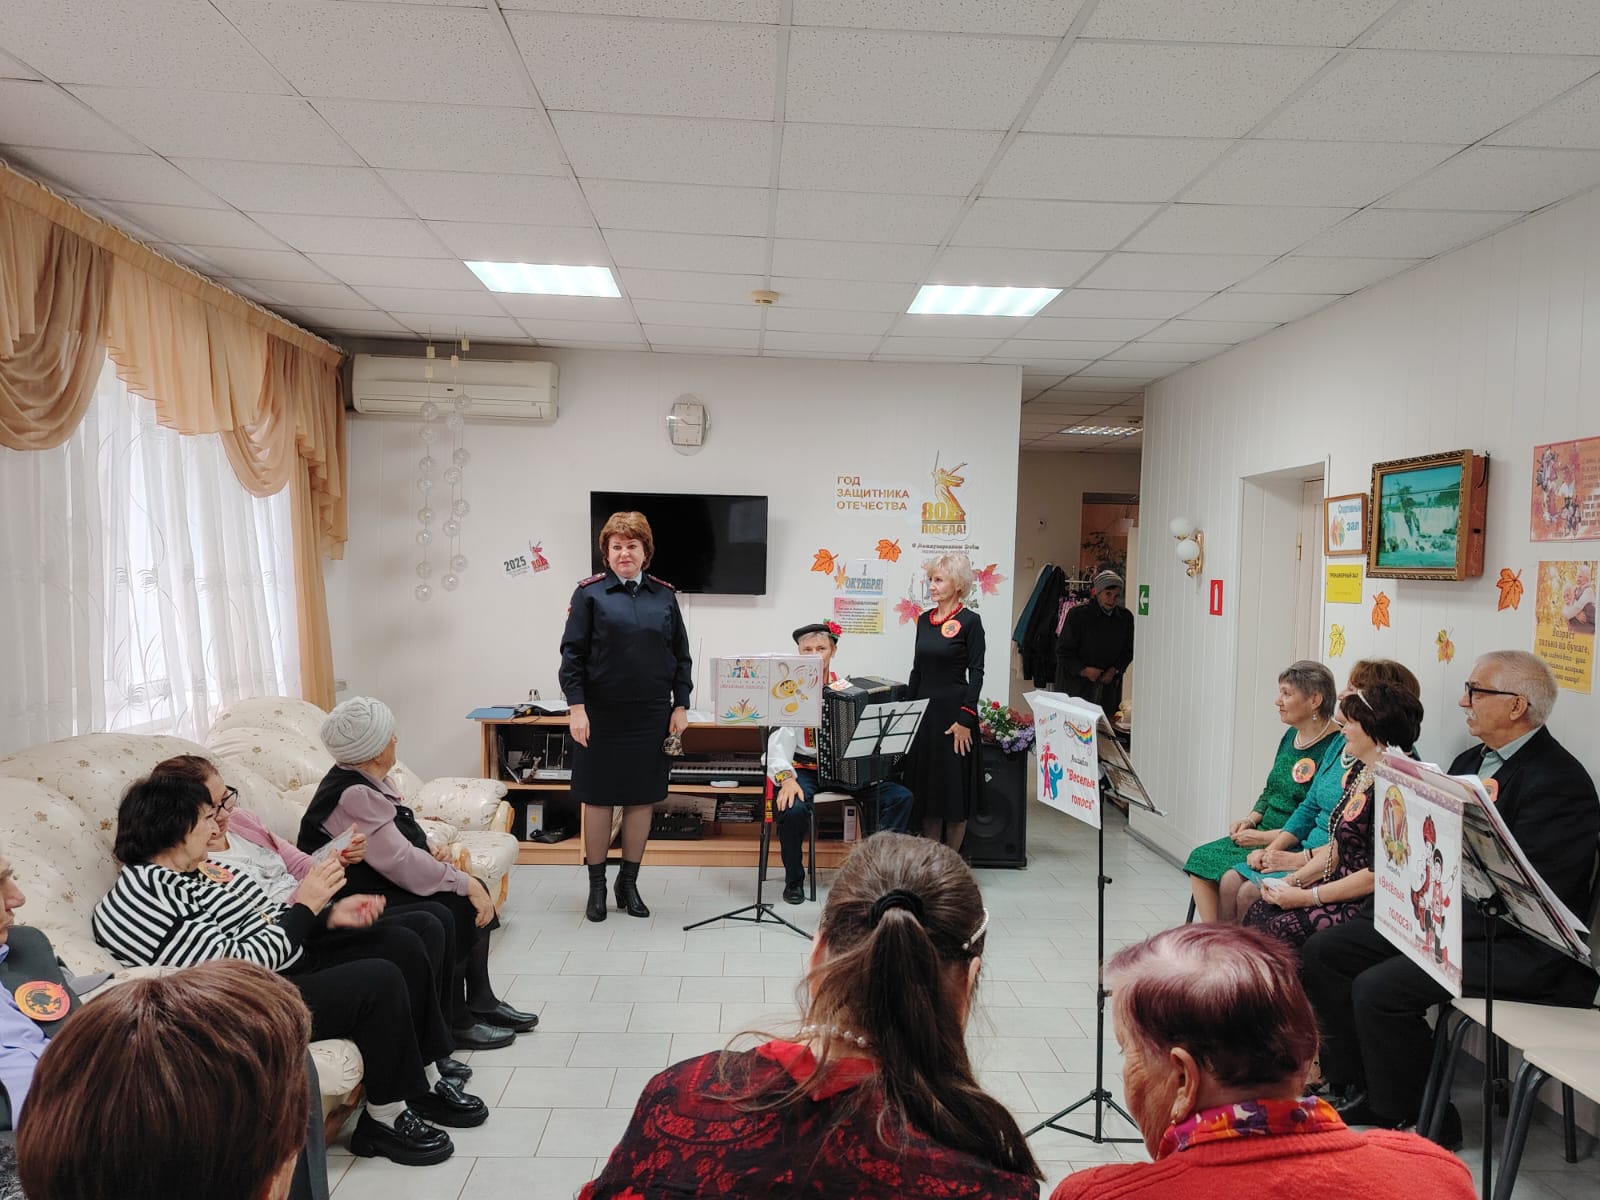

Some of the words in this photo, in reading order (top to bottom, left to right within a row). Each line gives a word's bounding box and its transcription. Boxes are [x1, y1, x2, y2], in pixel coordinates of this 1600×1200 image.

[837, 476, 861, 486] ГОД
[836, 488, 910, 499] ЗАЩИТНИКА
[836, 501, 908, 511] ОТЕЧЕСТВА
[921, 502, 943, 520] 80
[921, 524, 967, 536] ПОБЕДА!
[503, 555, 527, 572] 2025
[845, 577, 884, 590] ОКТЯБРЯ!
[1551, 627, 1575, 640] Возраст
